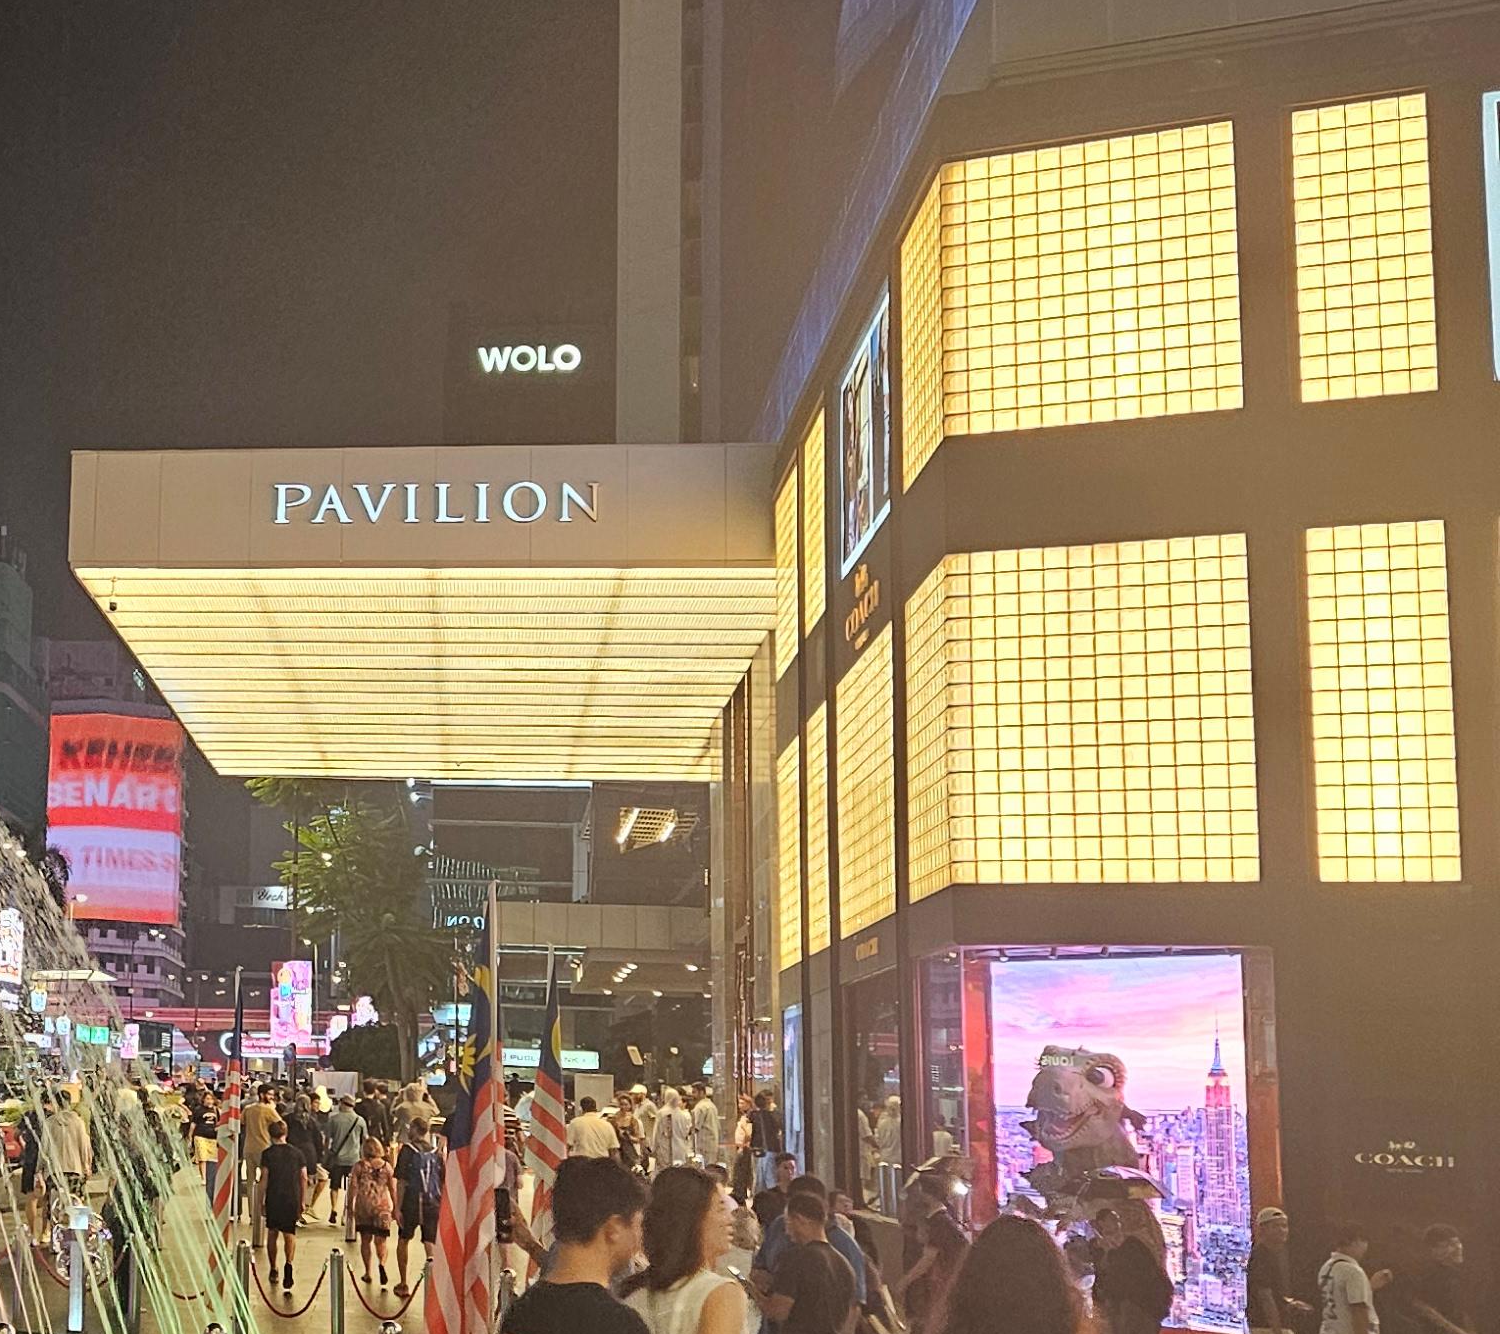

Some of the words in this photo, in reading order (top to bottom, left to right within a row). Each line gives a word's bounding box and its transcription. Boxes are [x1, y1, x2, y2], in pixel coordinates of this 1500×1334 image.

[478, 344, 582, 373] WOLO
[273, 481, 600, 524] PAVILION
[1354, 1153, 1455, 1167] COACH
